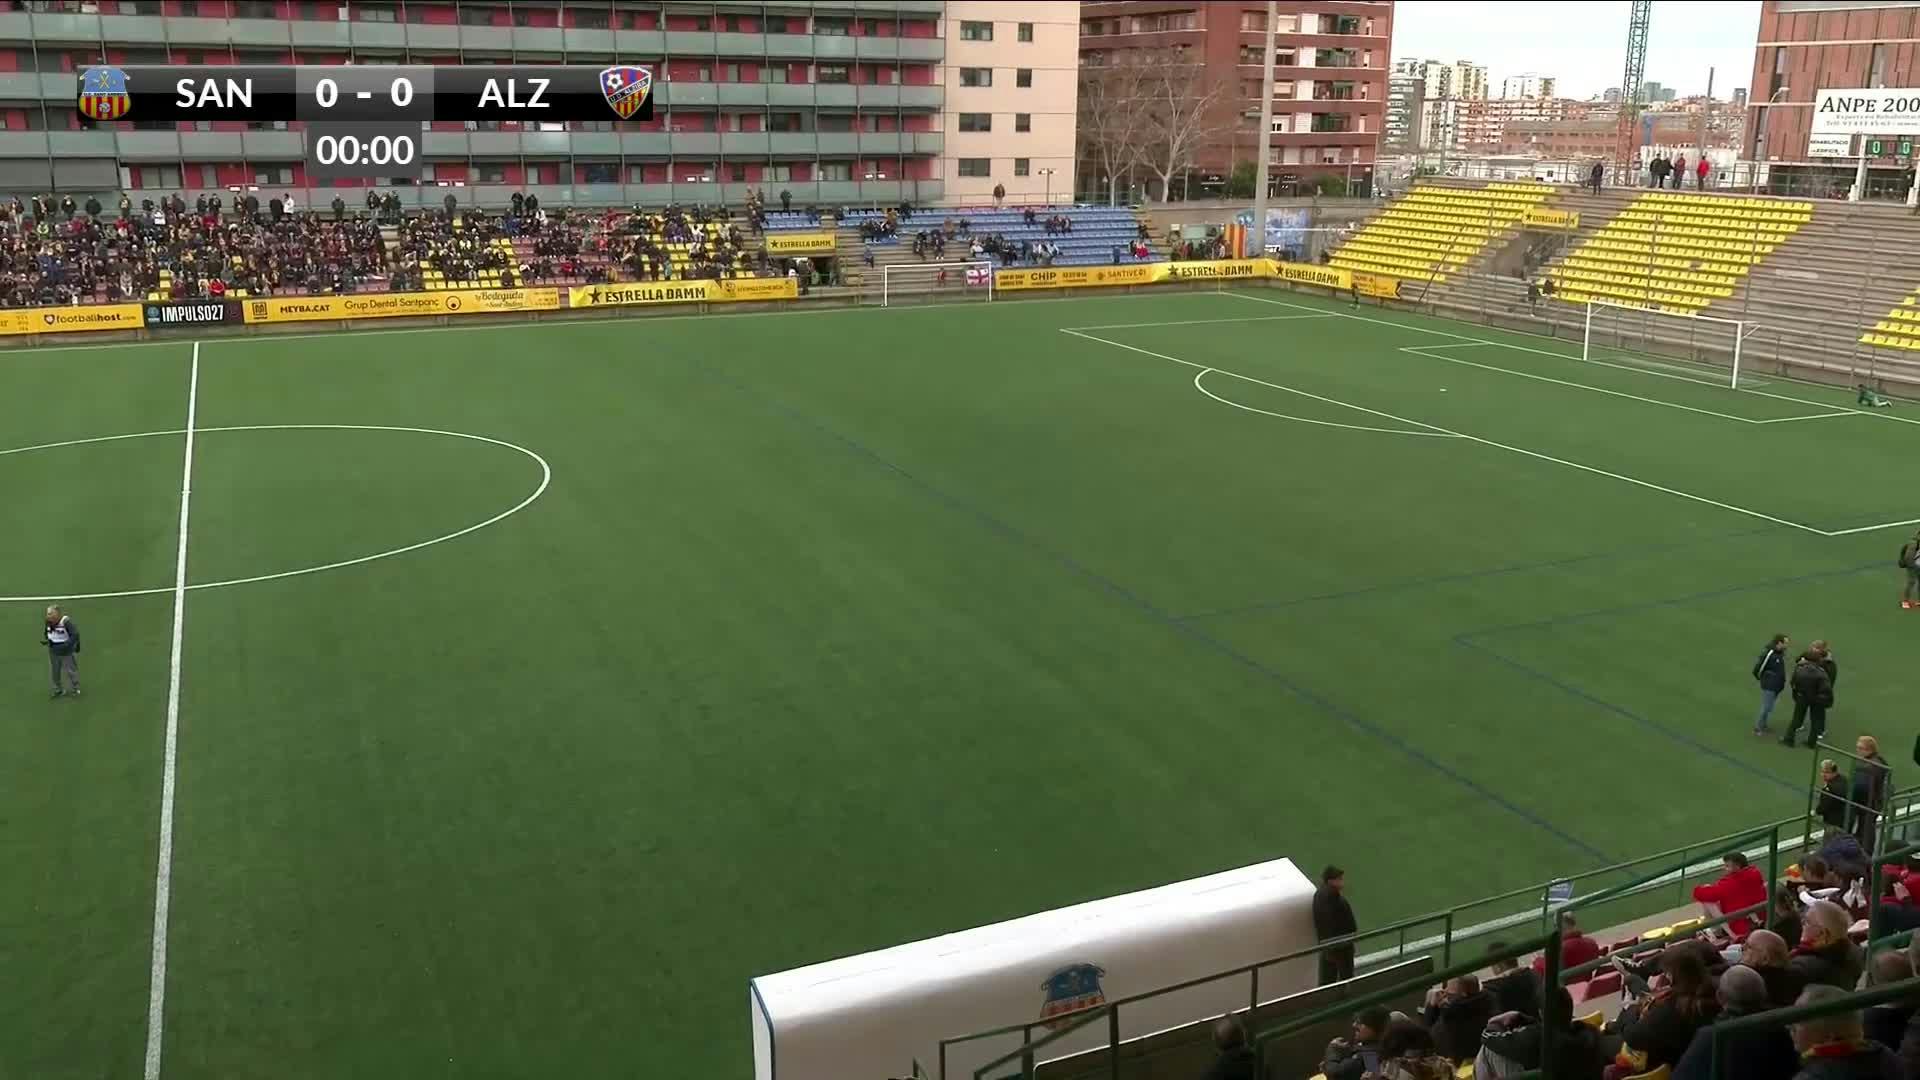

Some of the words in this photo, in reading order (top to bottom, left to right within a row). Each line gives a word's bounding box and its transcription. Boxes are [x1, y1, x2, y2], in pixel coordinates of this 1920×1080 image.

[1819, 96, 1877, 112] ANPE
[780, 240, 810, 248] ESTRELLA
[1225, 265, 1253, 276] DAMM
[1285, 268, 1315, 282] ESTRELLA
[1316, 273, 1340, 286] DAMM
[605, 287, 664, 303] ESTRELLA
[666, 286, 706, 300] DAMM
[280, 304, 331, 314] MEYBA.CAT
[344, 300, 368, 311] Grup
[369, 298, 398, 308] Dental
[162, 304, 224, 322] IMPULSO27
